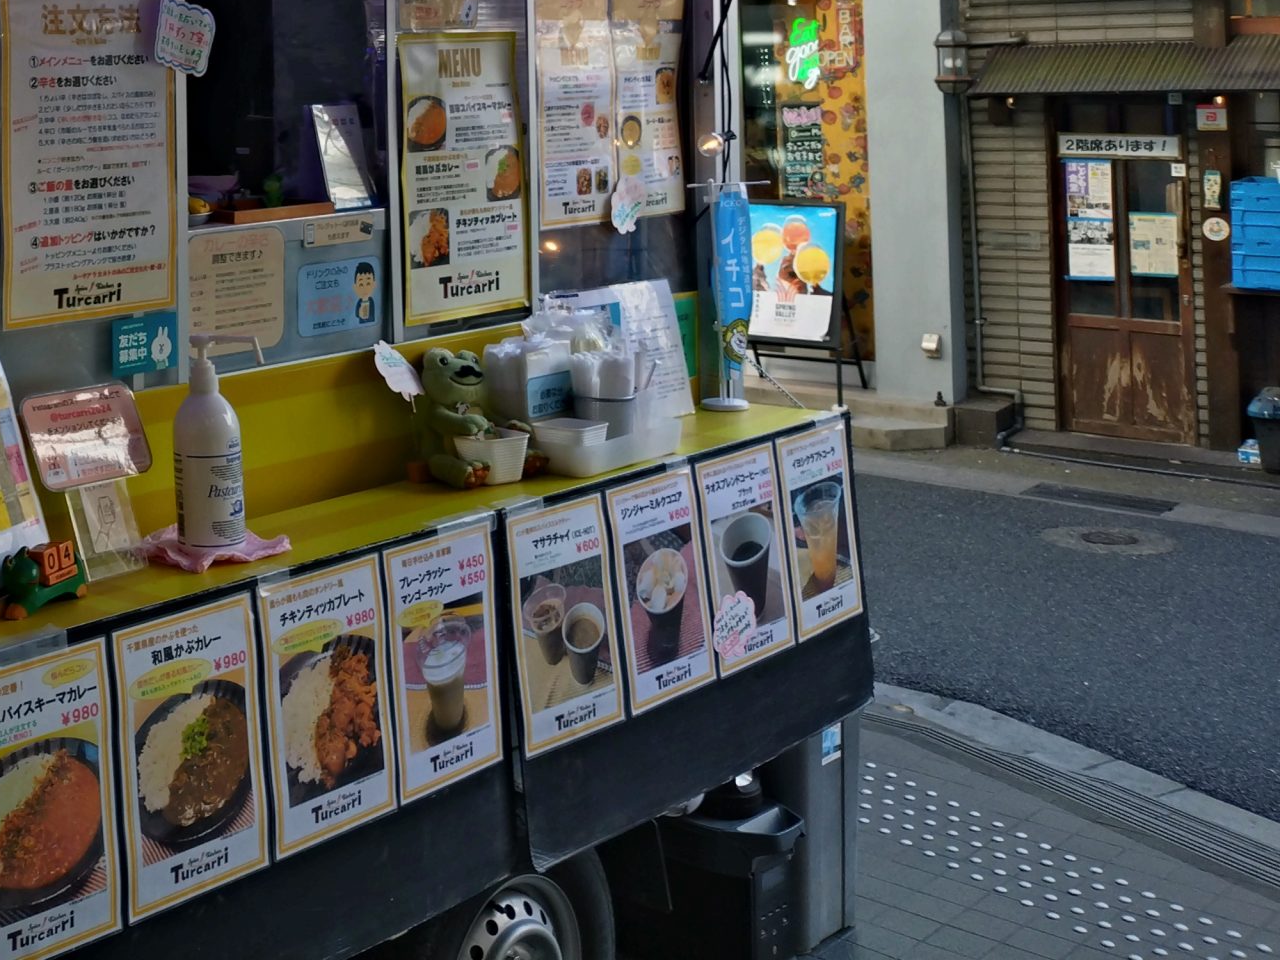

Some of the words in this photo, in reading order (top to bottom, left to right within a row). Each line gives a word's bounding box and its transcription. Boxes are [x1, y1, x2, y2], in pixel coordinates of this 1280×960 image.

[41, 3, 142, 35] 注文方法
[438, 48, 482, 78] MENU
[819, 50, 854, 66] OPEN
[29, 75, 118, 89] ②辛さをお選びください
[1065, 138, 1168, 153] 2階席あります！
[28, 175, 135, 194] ③ご飯の量をお選びください
[562, 199, 596, 216] Turcarri
[721, 227, 745, 308] イチコ
[53, 282, 122, 309] Turcarri
[314, 279, 340, 290] ご注文も
[439, 270, 501, 299] Turcarri
[118, 332, 148, 349] 友だち
[118, 346, 148, 364] 募集中
[50, 405, 112, 422] @turcarri2024
[532, 530, 570, 550] マサラチャイ
[576, 537, 599, 554] ¥600
[399, 567, 451, 590] プレーンラッシー
[458, 554, 485, 572] ¥450
[401, 583, 453, 605] マンゴーラッシー
[460, 570, 486, 587] ¥550
[280, 588, 365, 628] チキンティッカプレート
[346, 607, 375, 628] ¥980
[816, 595, 844, 618] Turcarri
[151, 635, 222, 666] 和風かぶカレー
[214, 650, 246, 672] ¥980
[655, 663, 692, 691] Turcarri
[61, 703, 99, 727] ¥980
[555, 703, 597, 732] Turcarri
[430, 742, 474, 773] Turcarri
[311, 790, 362, 824] Turcarri
[170, 846, 229, 884] Turcarri
[7, 910, 75, 952] Turcarri
